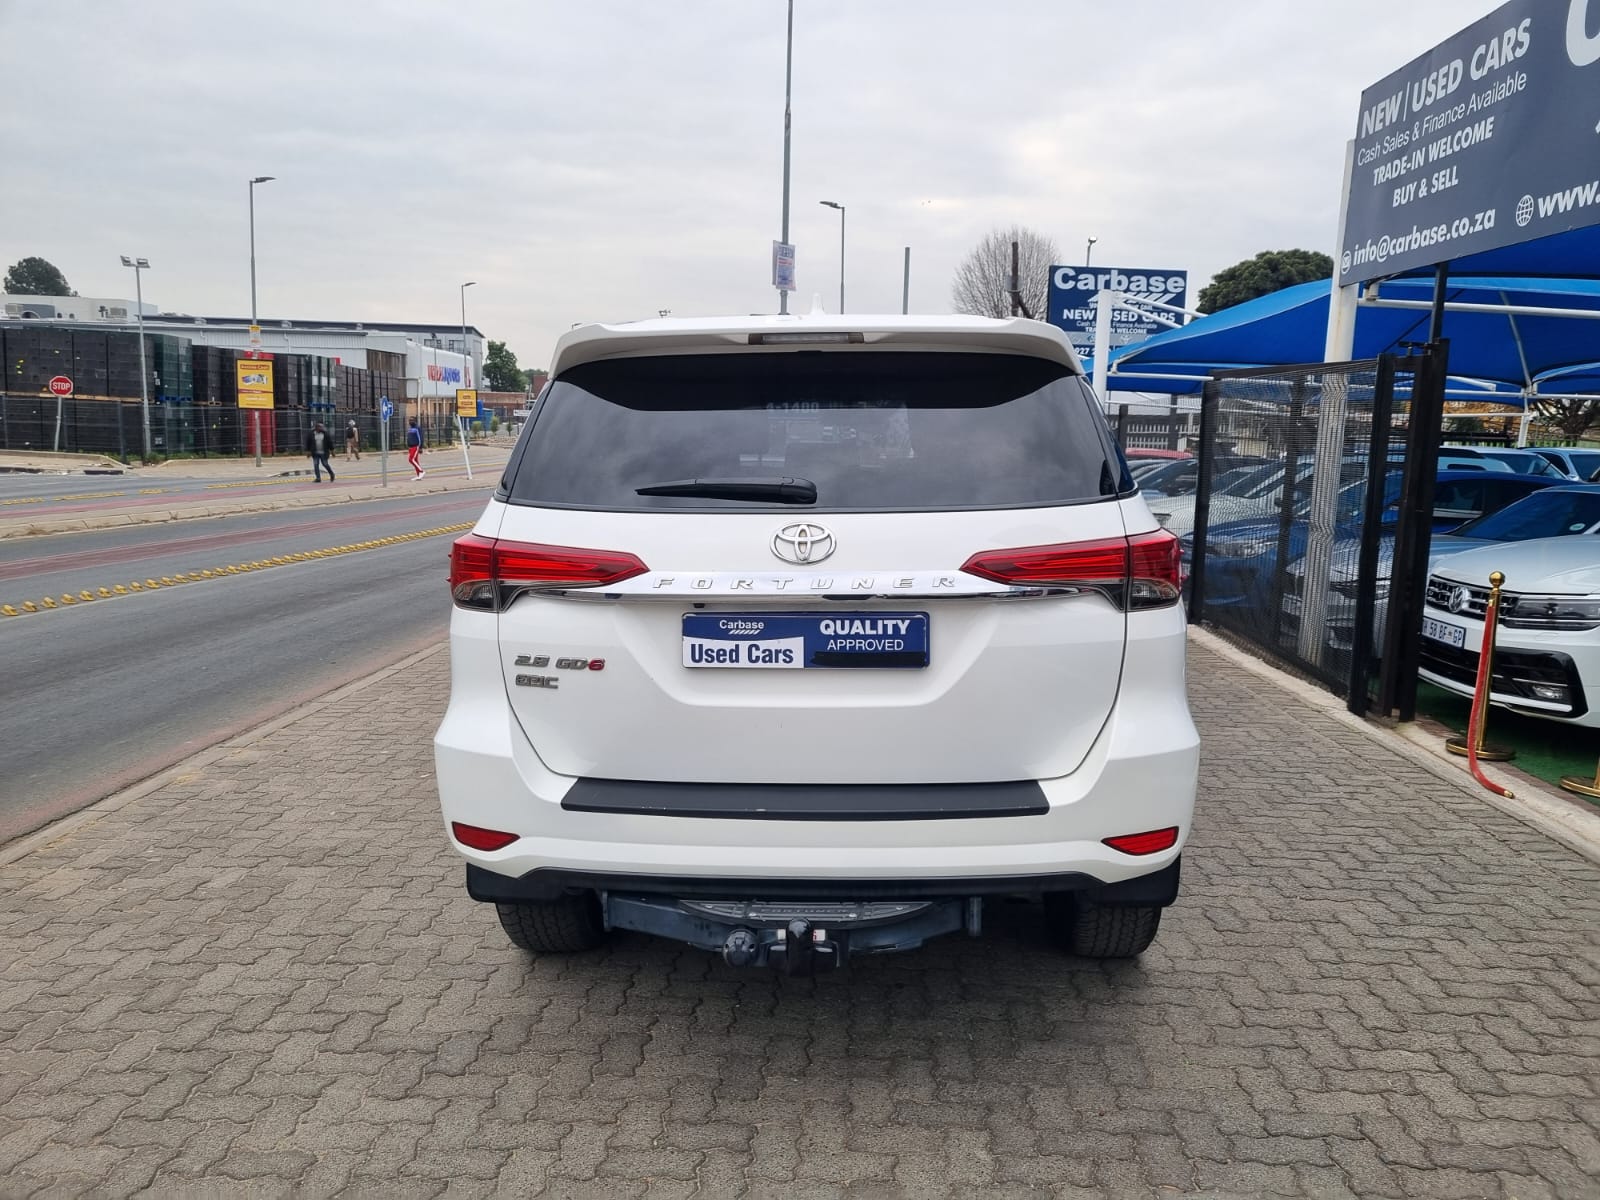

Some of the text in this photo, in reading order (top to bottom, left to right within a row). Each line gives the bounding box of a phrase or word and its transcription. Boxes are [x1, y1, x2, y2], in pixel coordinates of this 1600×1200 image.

[1361, 90, 1403, 138] NEW
[1412, 58, 1463, 113] USED
[1470, 17, 1532, 81] CARS
[1358, 71, 1527, 166] Cash Sales & Finance Available
[1373, 116, 1495, 187] TRADE-IN WELCOME
[1392, 165, 1459, 208] BUY & SELL
[1353, 209, 1495, 265] info@carbase.co.za
[1054, 268, 1185, 293] Carbase
[1063, 309, 1095, 320] NEW
[1111, 311, 1138, 322] SED
[52, 382, 70, 390] STOP
[653, 576, 955, 590] FORTUNER
[720, 619, 764, 629] Carbase
[820, 620, 910, 635] QUALITY
[691, 644, 794, 664] Used Cars
[827, 639, 904, 651] APPROVED
